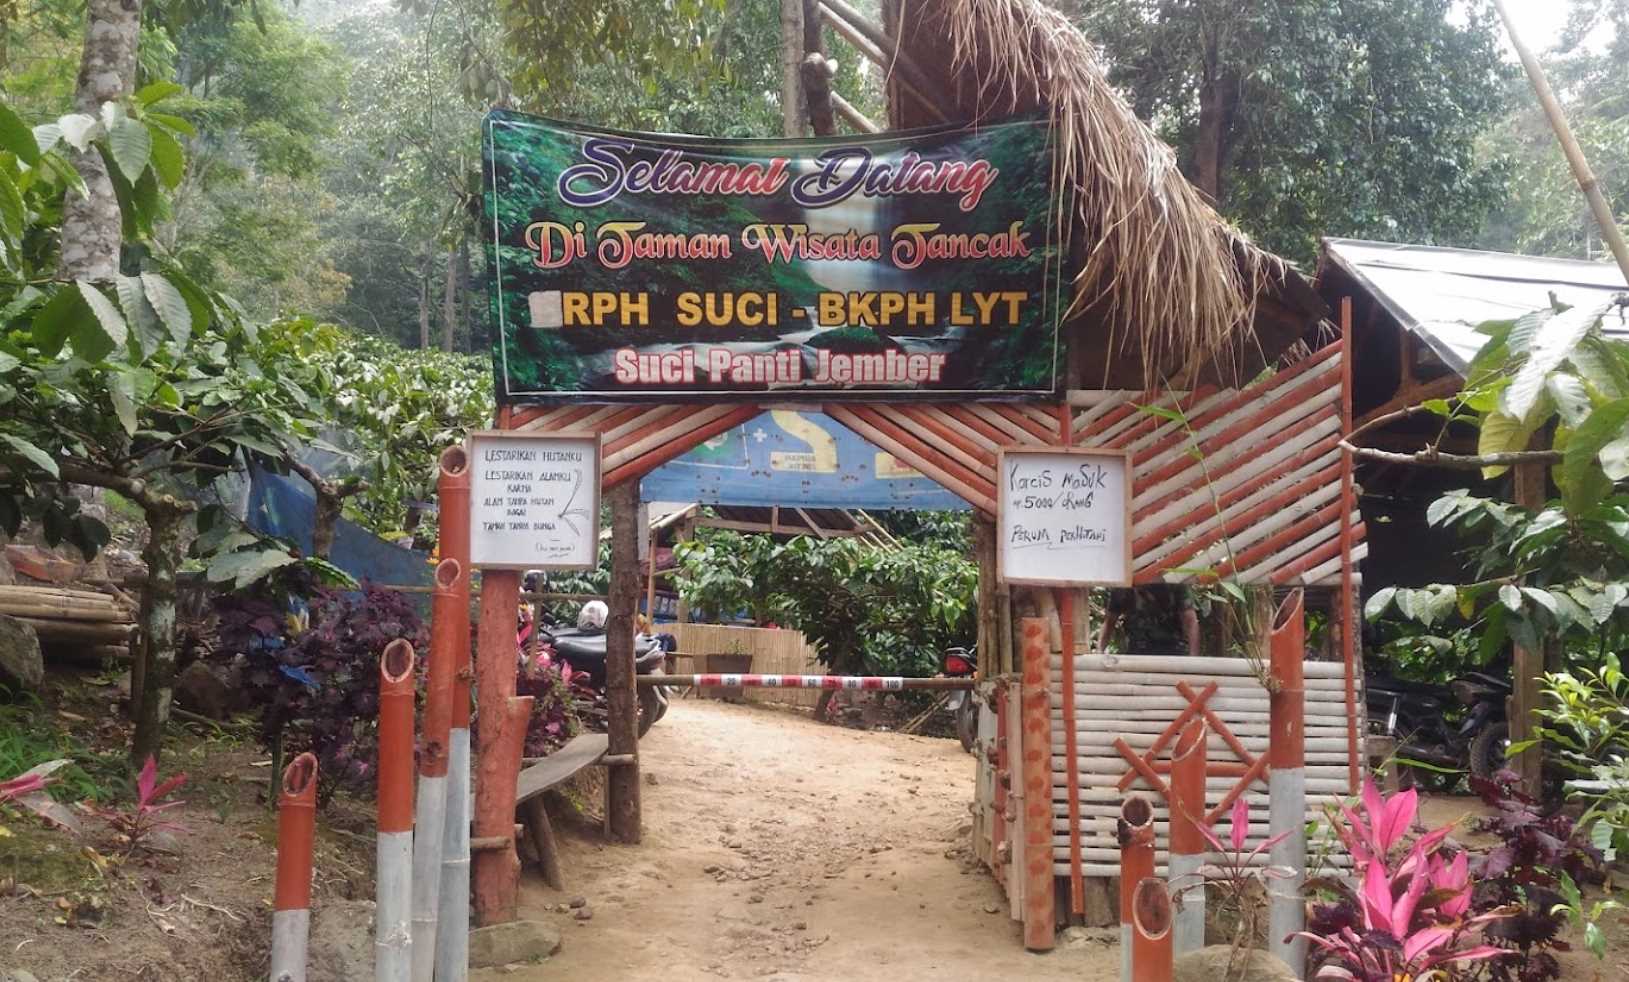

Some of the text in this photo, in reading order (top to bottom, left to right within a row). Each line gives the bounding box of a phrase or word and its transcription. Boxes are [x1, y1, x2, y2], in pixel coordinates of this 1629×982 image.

[558, 137, 1000, 213] Selamat Datang
[525, 220, 1032, 270] Di Taman Wisata Tancak
[562, 291, 650, 326] RPH
[677, 291, 779, 327] SUCI
[819, 291, 941, 327] BKPH
[949, 291, 1028, 326] LYT
[614, 347, 947, 385] Suci Panti Jember
[485, 449, 582, 462] LESTARIKAN HUTANKU
[485, 470, 533, 481] LESTARIKAN
